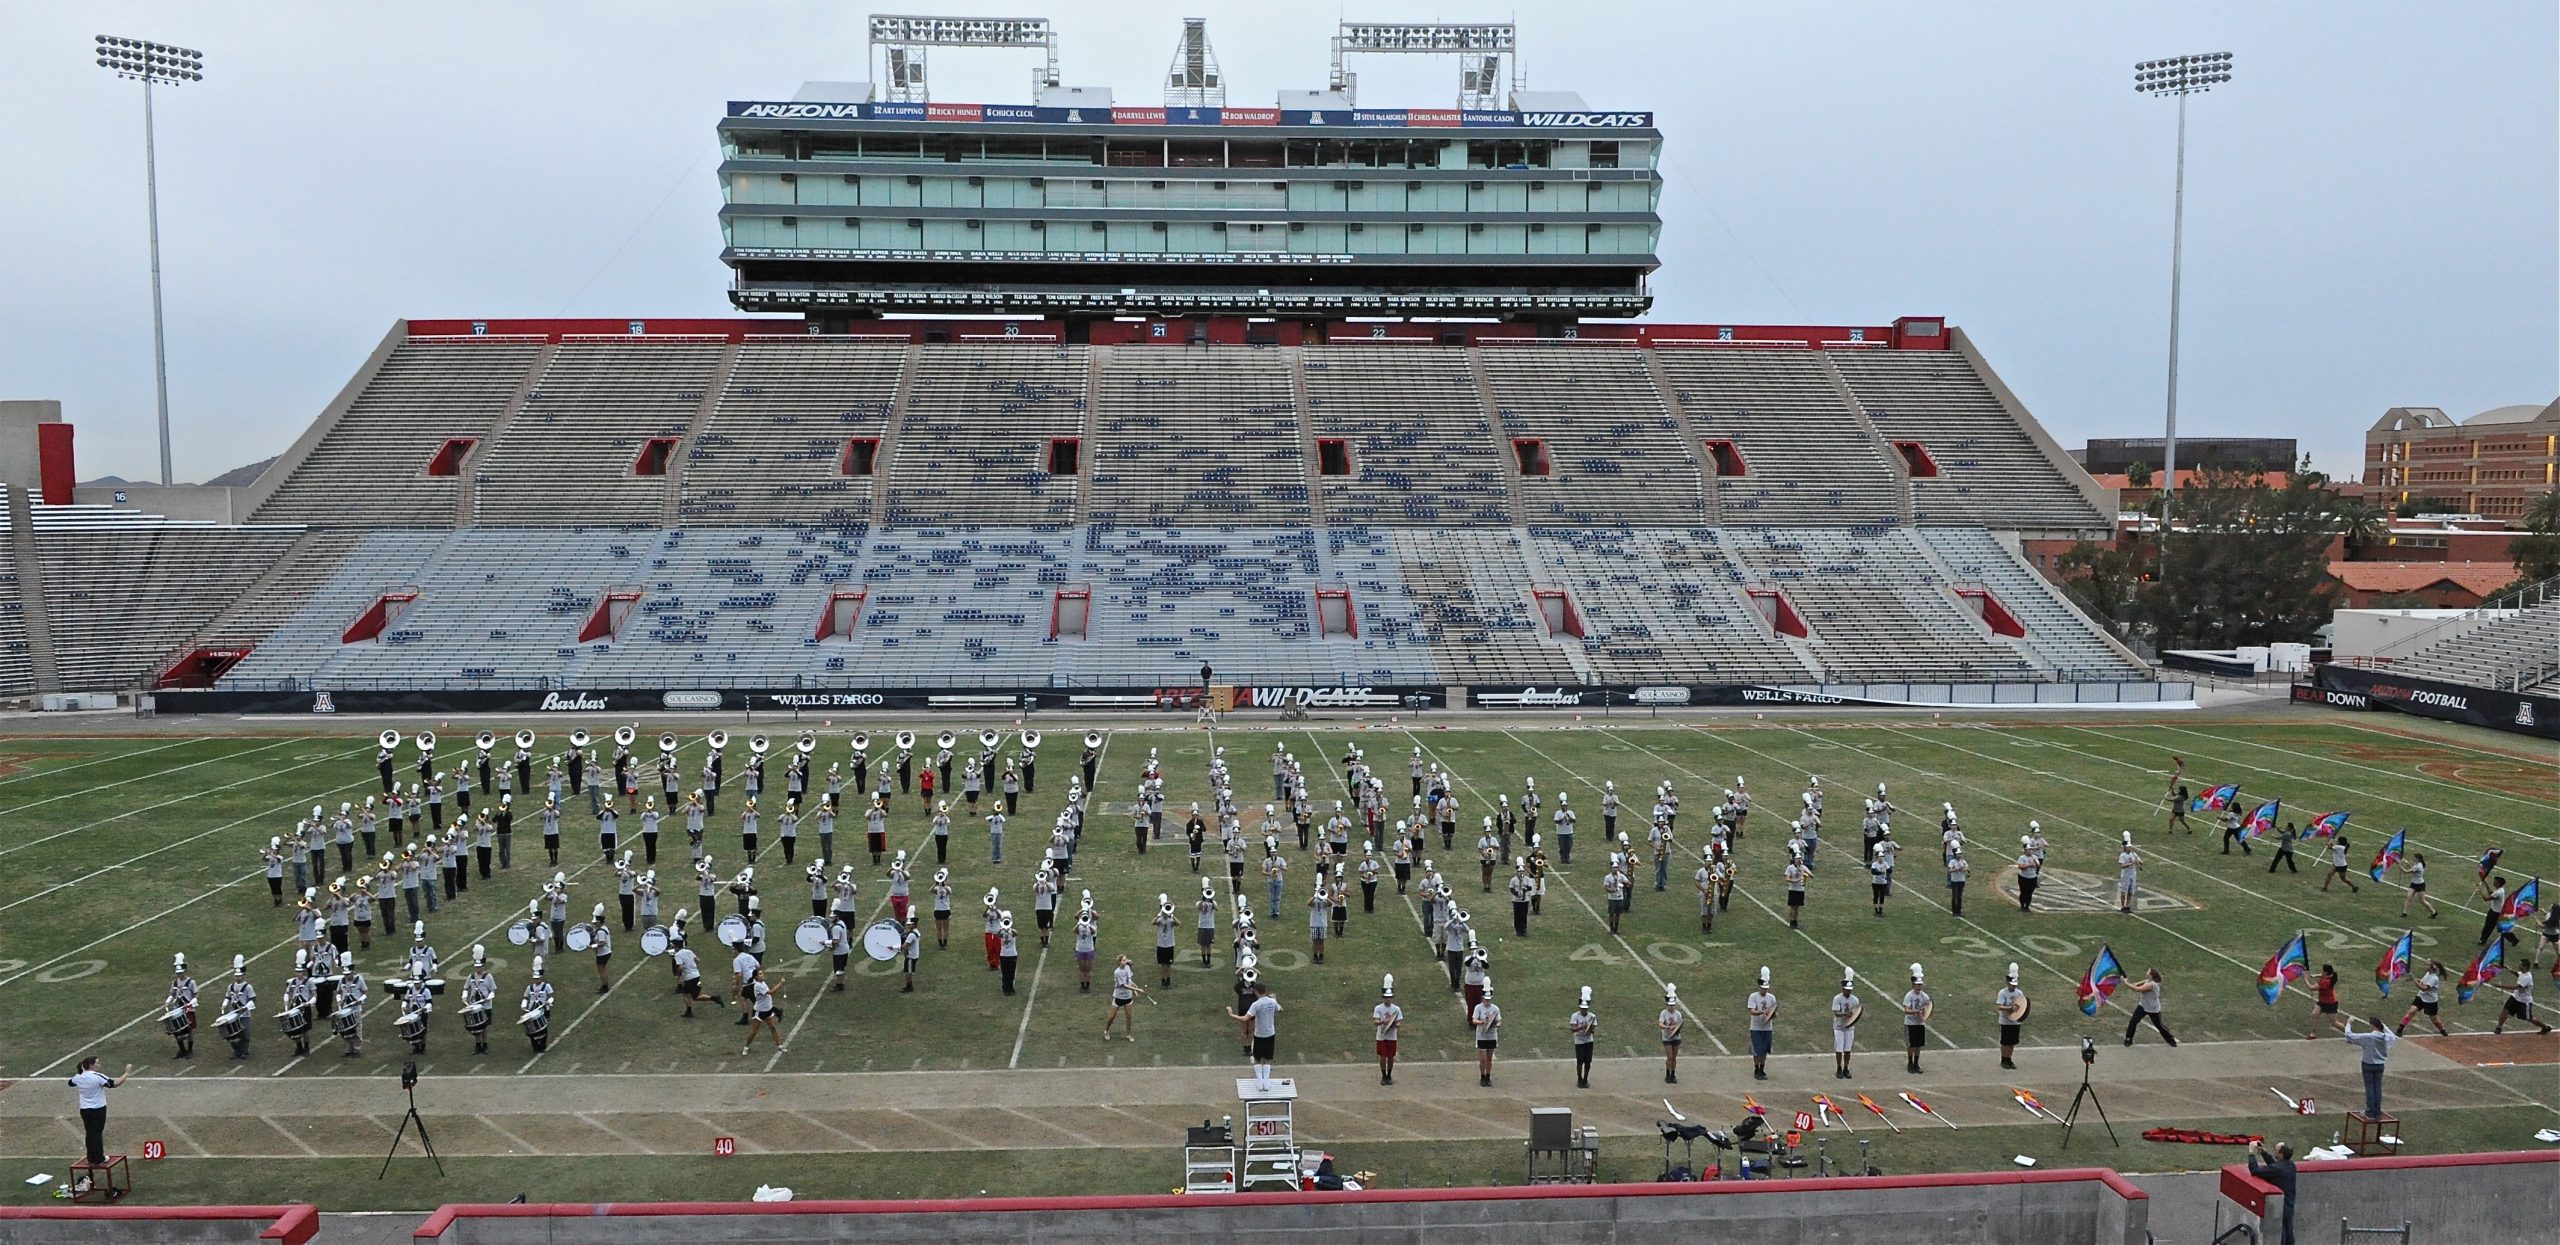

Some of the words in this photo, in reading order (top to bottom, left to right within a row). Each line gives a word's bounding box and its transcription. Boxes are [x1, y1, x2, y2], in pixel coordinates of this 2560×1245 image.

[741, 105, 858, 117] ARIZONA
[874, 106, 881, 114] 22
[992, 109, 1015, 117] CHUCK
[1493, 115, 1515, 123] CASON
[1523, 113, 1646, 127] WILDCATS
[474, 326, 485, 335] 17
[630, 326, 643, 335] 18
[808, 326, 820, 335] 19
[1005, 326, 1019, 336] 20
[1154, 327, 1165, 336] 21
[1373, 328, 1385, 338] 22
[1565, 330, 1577, 339] 23
[1719, 332, 1732, 341] 24
[1850, 333, 1863, 342] 25
[115, 492, 126, 501] 16
[777, 694, 830, 705] WELLS
[832, 694, 884, 705] FARGO
[1152, 688, 1253, 706] ARIZA
[1742, 690, 1792, 701] WELLS
[2296, 688, 2326, 701] BEAR
[2327, 691, 2366, 708] DOWN
[2369, 684, 2411, 699] ARIZONA
[2410, 690, 2467, 710] FOOTBALL
[540, 692, 608, 711] Bashas'
[1570, 943, 1701, 965] 40
[2301, 1099, 2316, 1115] 30
[1796, 1113, 1810, 1130] 40
[1259, 1121, 1275, 1135] 50
[145, 1142, 162, 1158] 30
[717, 1139, 733, 1154] 40
